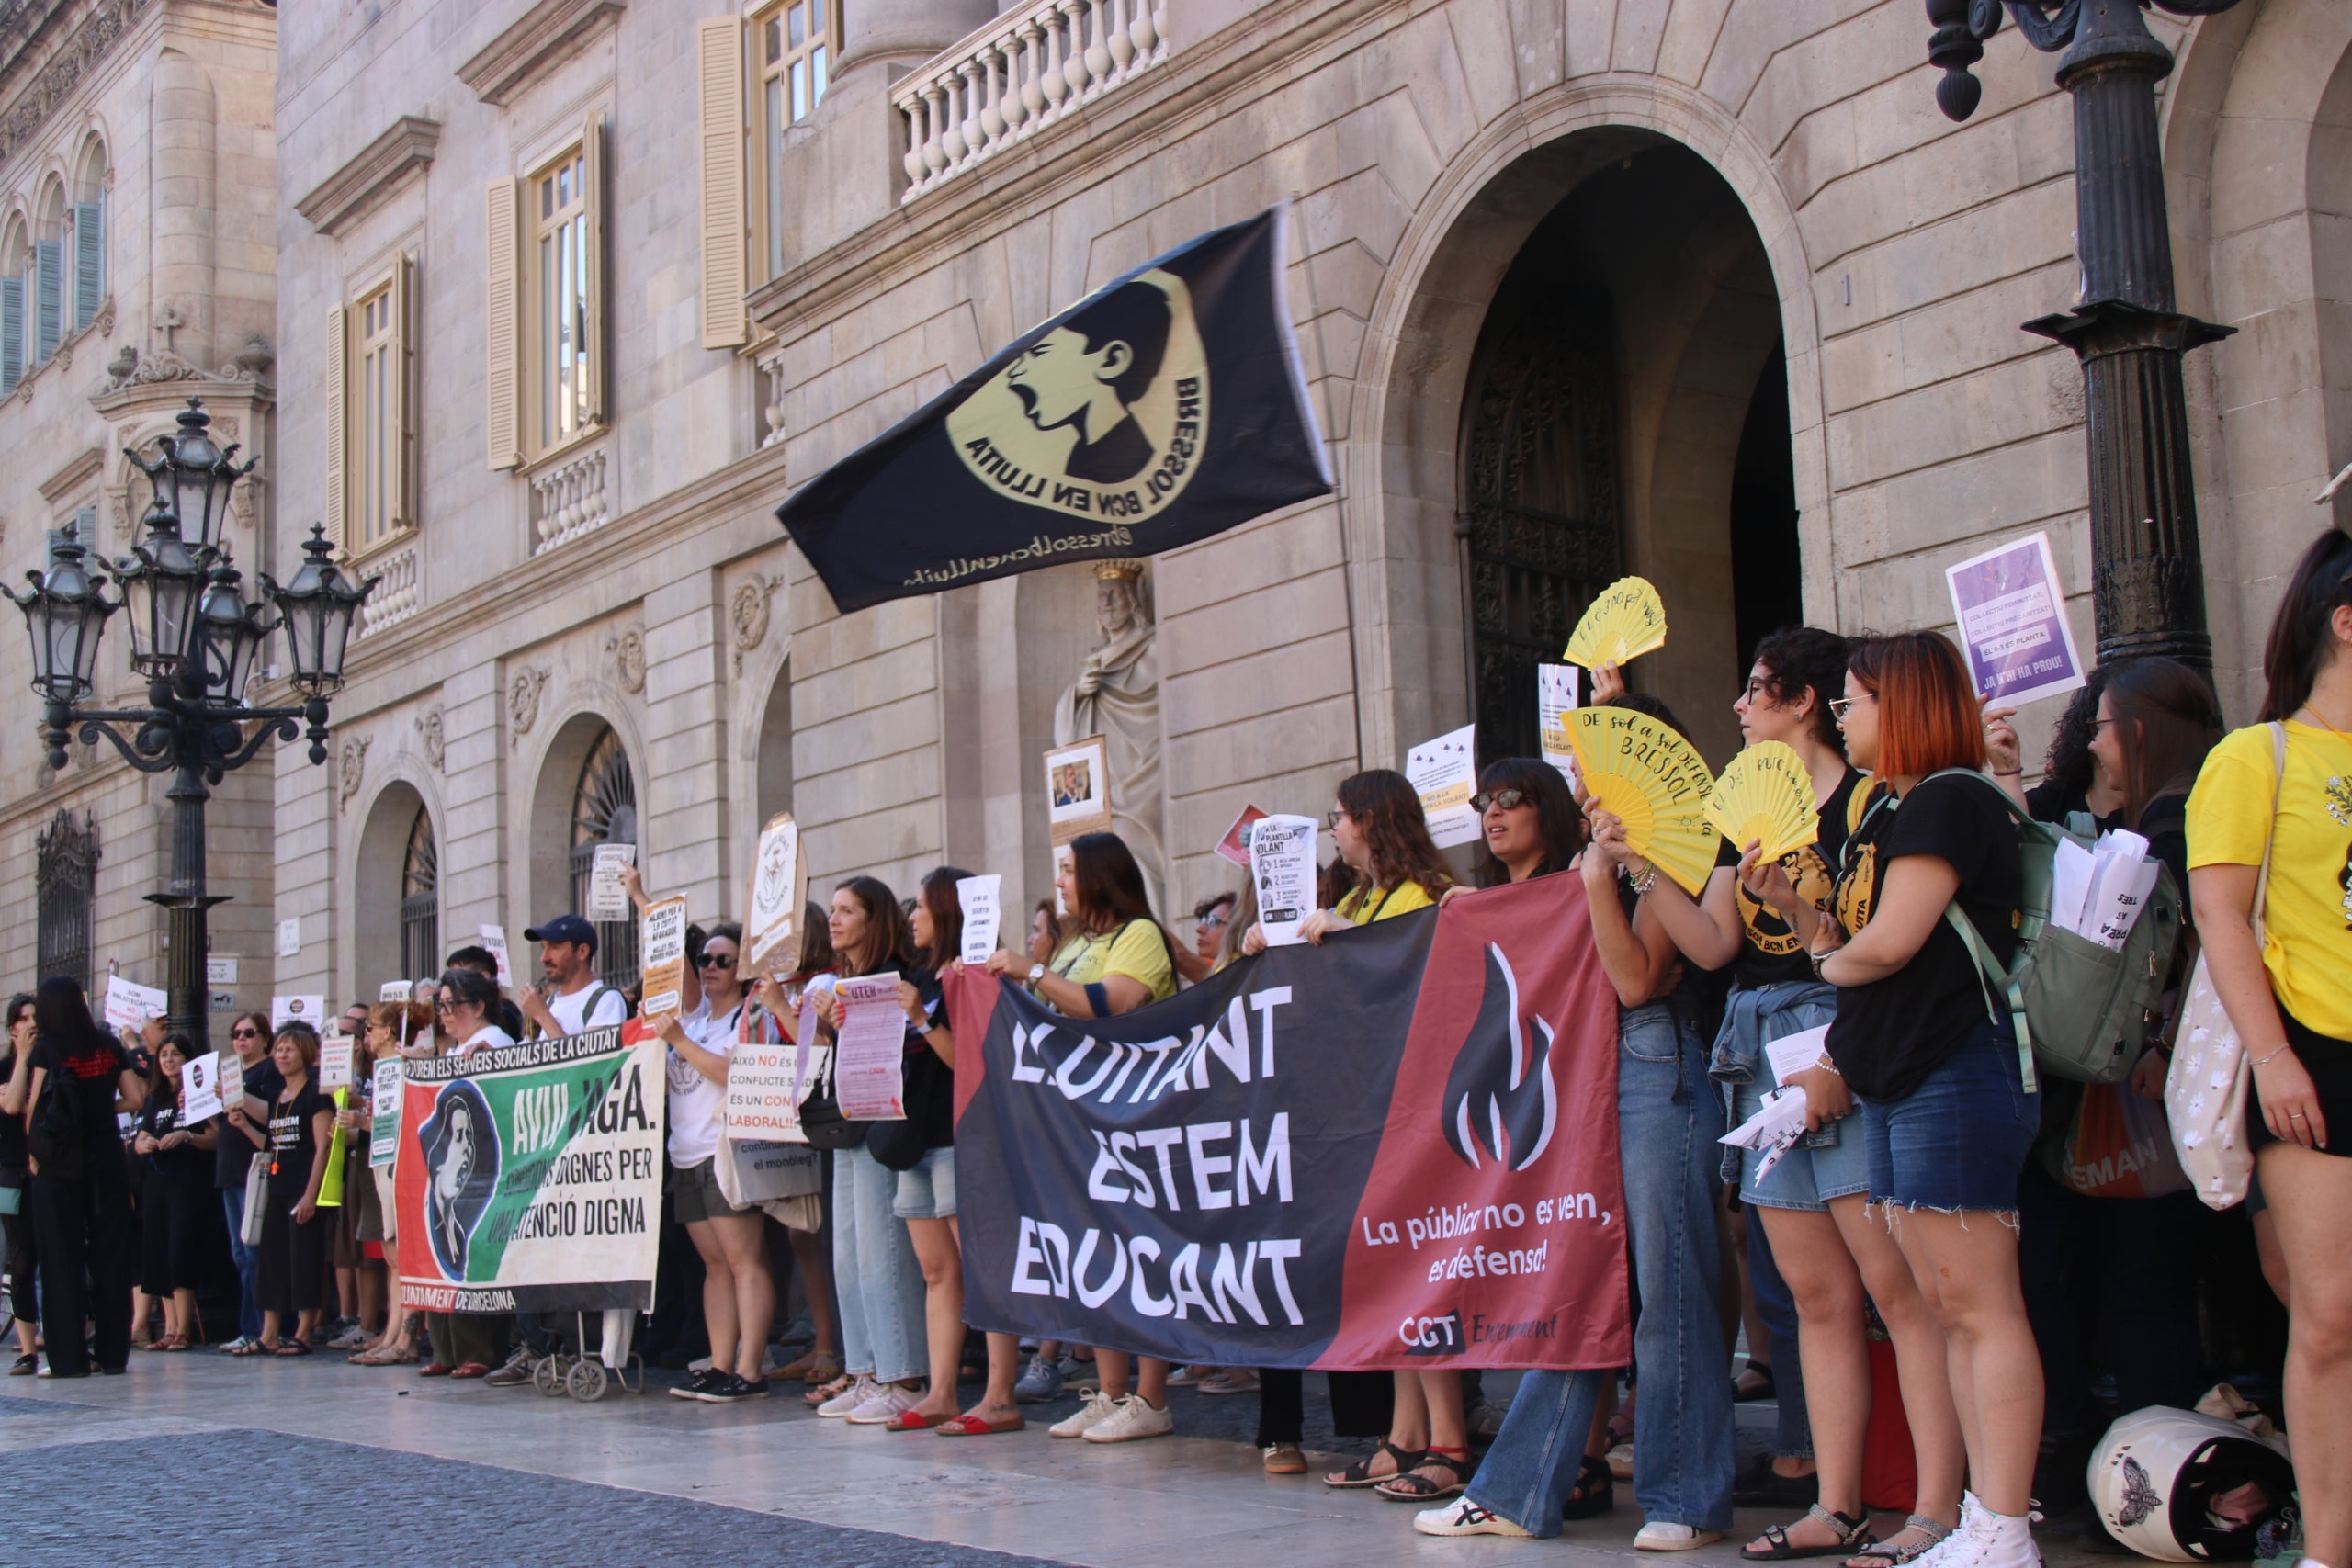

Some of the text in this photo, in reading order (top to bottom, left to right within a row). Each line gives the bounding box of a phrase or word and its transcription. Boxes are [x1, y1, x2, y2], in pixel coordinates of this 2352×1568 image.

[1984, 648, 1993, 656] EL
[2016, 631, 2045, 645] PLANTA
[1984, 655, 2063, 689] JA N'HI HA PROU!
[1582, 713, 1600, 727] DE
[1610, 716, 1638, 731] sol
[1640, 727, 1654, 738] a
[1657, 733, 1682, 753] sol
[1621, 736, 1690, 806] BRESSOL
[1255, 841, 1284, 854] VOLANT
[1266, 831, 1293, 841] PLANTILLA
[1273, 859, 1278, 868] 1
[1274, 875, 1280, 886] 2
[1276, 891, 1281, 901] 3
[1764, 941, 1784, 952] BCN
[436, 1057, 453, 1078] ELS
[454, 1051, 493, 1077] SERVEIS
[493, 1044, 540, 1070] SOCIALS
[542, 1040, 559, 1061] DE
[560, 1037, 575, 1057] LA
[577, 1026, 619, 1055] CIUTAT
[730, 1055, 793, 1067] AIXÒ NO ÉS
[730, 1075, 786, 1087] CONFLICTE
[730, 1095, 743, 1105] ÉS
[746, 1096, 762, 1107] UN
[513, 1082, 569, 1156] AVUI
[555, 1150, 614, 1186] DIGNES
[619, 1147, 653, 1181] PER
[753, 1152, 818, 1171] el monòleg?
[1089, 1111, 1293, 1211] ESTEM
[512, 1194, 577, 1241] ATENCIÓ
[584, 1196, 646, 1236] DIGNA
[1363, 1192, 1611, 1250] La pública no es ven,
[1011, 1215, 1303, 1325] EDUCANT
[1427, 1239, 1548, 1283] es defensa!
[1398, 1315, 1456, 1348] CGT
